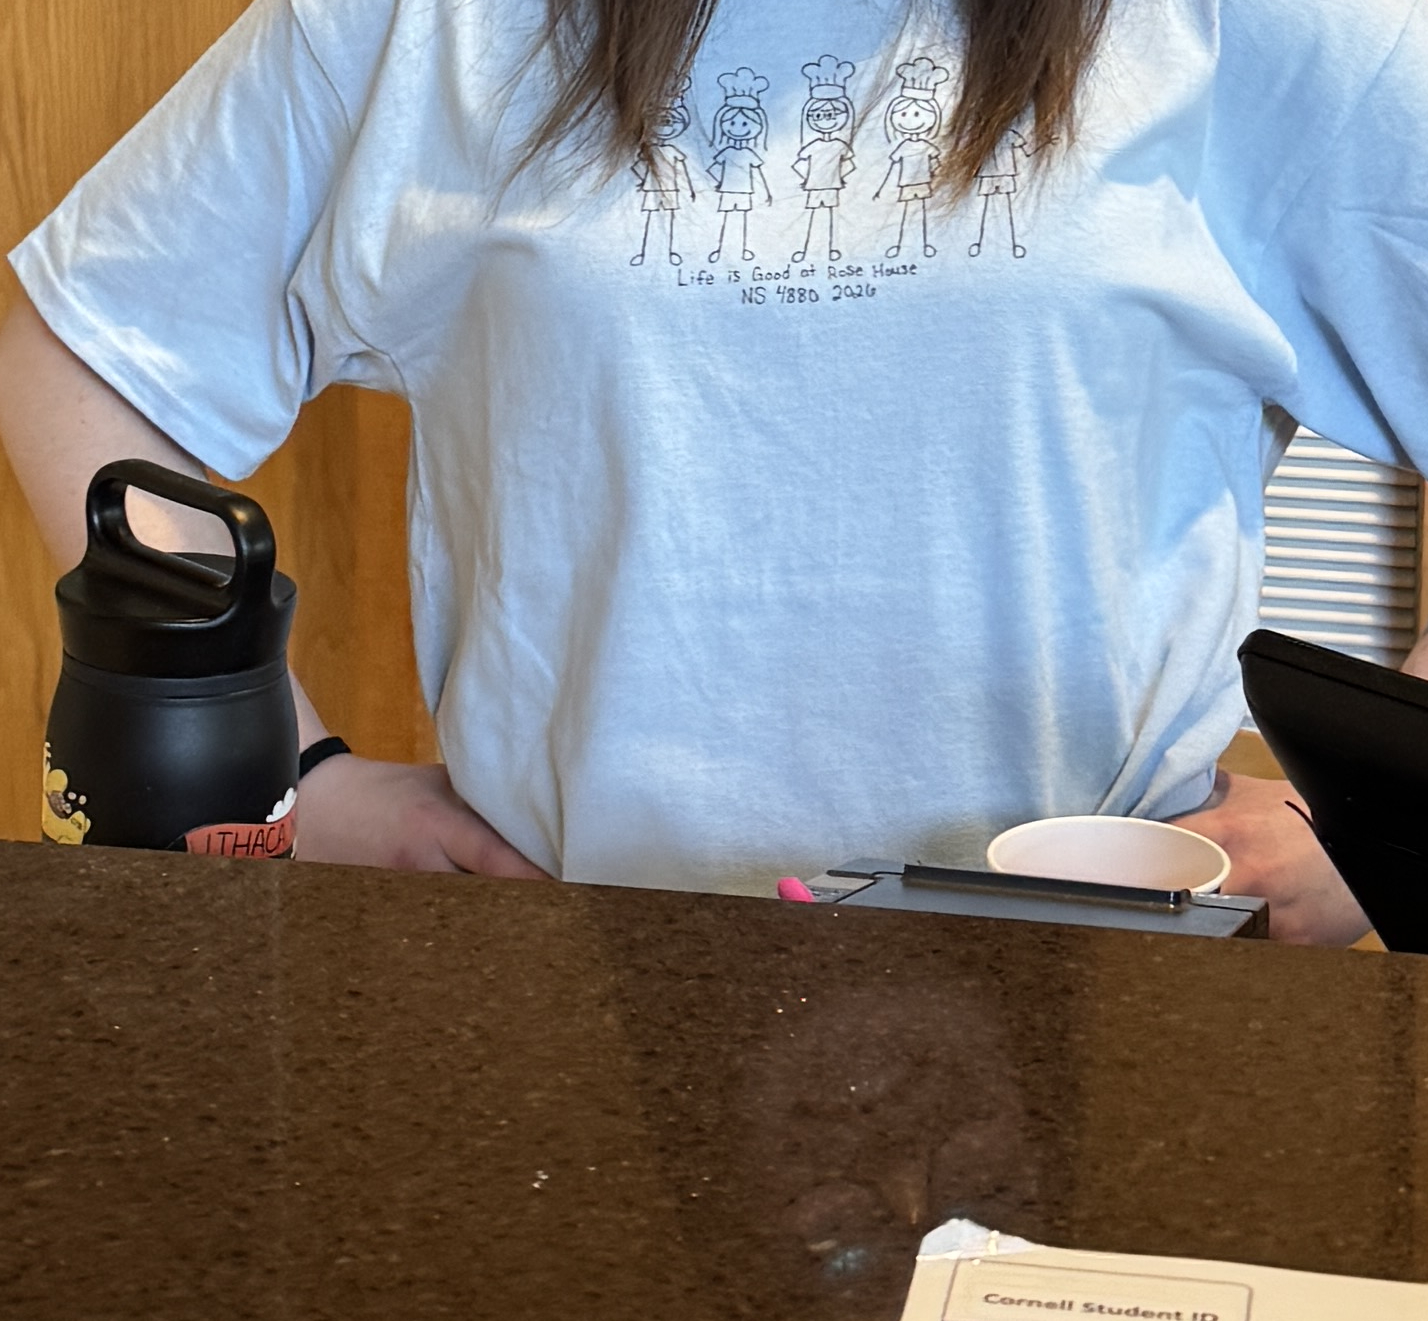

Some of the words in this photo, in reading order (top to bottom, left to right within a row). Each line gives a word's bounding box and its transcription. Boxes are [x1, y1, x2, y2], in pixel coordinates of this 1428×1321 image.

[677, 268, 715, 287] Life
[727, 270, 742, 284] is
[752, 263, 791, 282] Good
[800, 264, 817, 278] at
[828, 264, 864, 279] Rose
[872, 263, 918, 278] House
[741, 286, 767, 305] NS
[775, 285, 820, 304] 4880
[831, 283, 877, 302] 2026
[206, 824, 286, 858] ITHACA
[982, 1293, 1074, 1311] Cornell
[1082, 1302, 1183, 1321] Student
